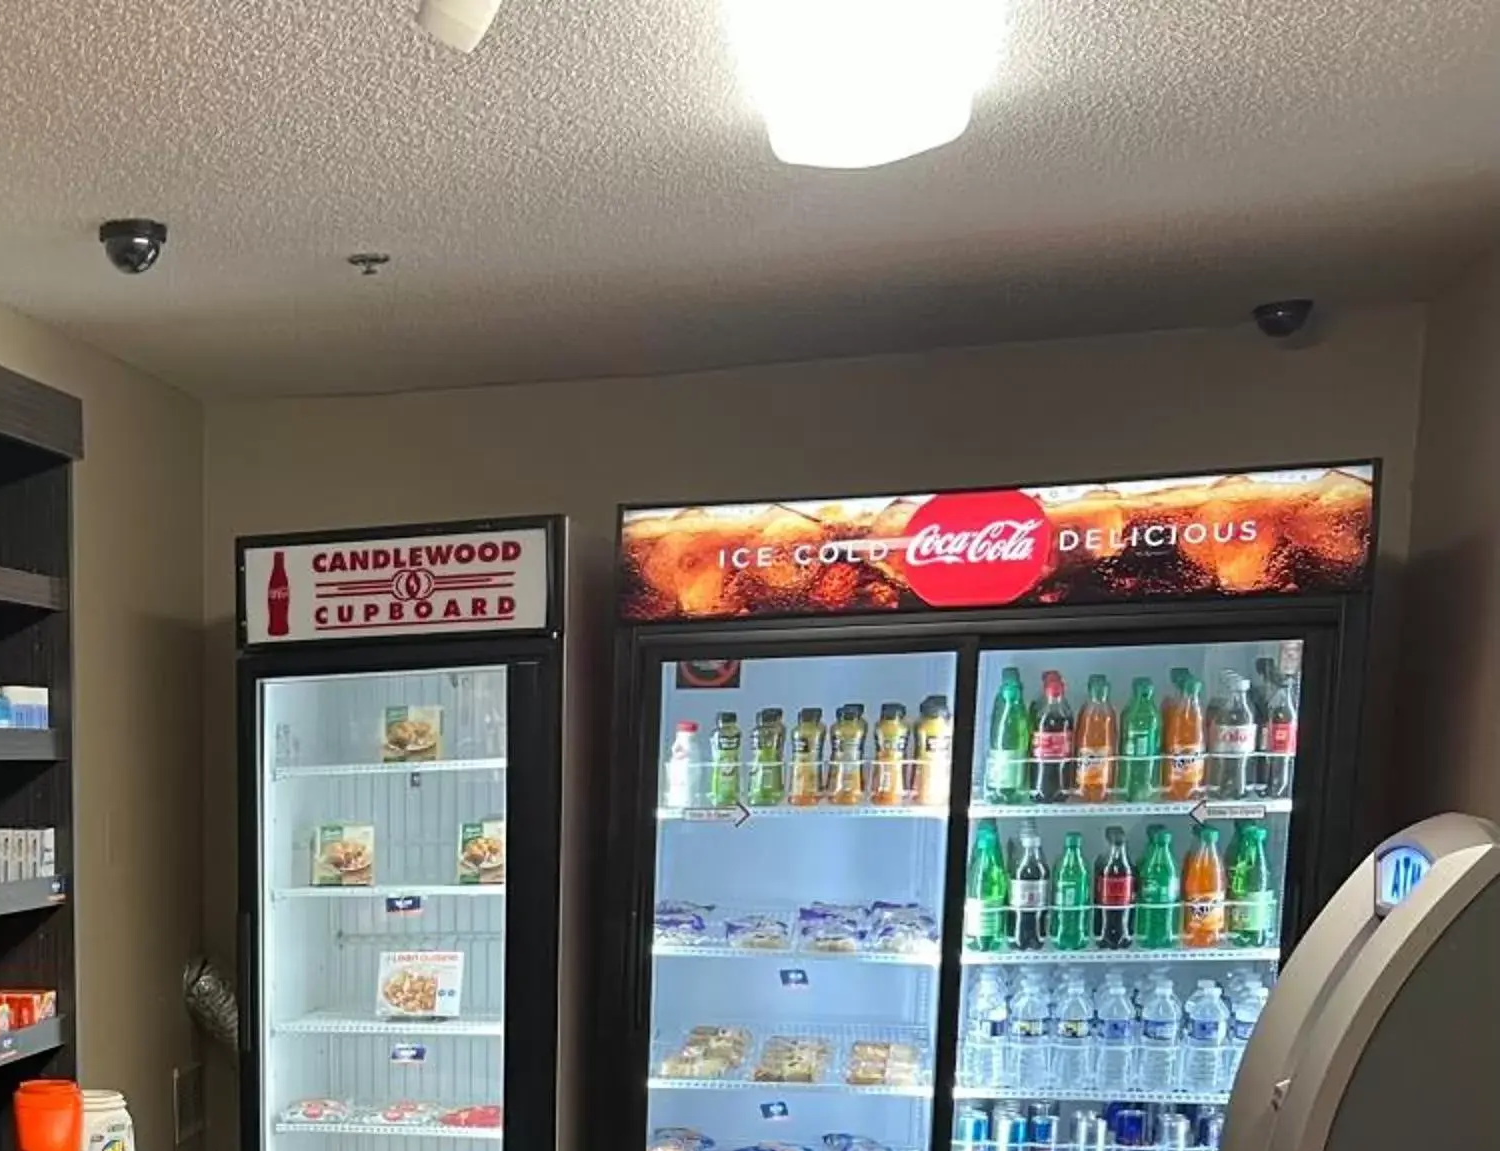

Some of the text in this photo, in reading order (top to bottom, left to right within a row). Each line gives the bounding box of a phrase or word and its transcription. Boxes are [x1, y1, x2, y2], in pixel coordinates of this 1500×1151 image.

[905, 519, 1044, 565] Coca-Cola
[1059, 520, 1258, 551] DELICIOUS
[312, 541, 522, 574] CANDLEWOOD
[718, 541, 889, 569] ICE COLD
[314, 595, 516, 625] CUPBOARD
